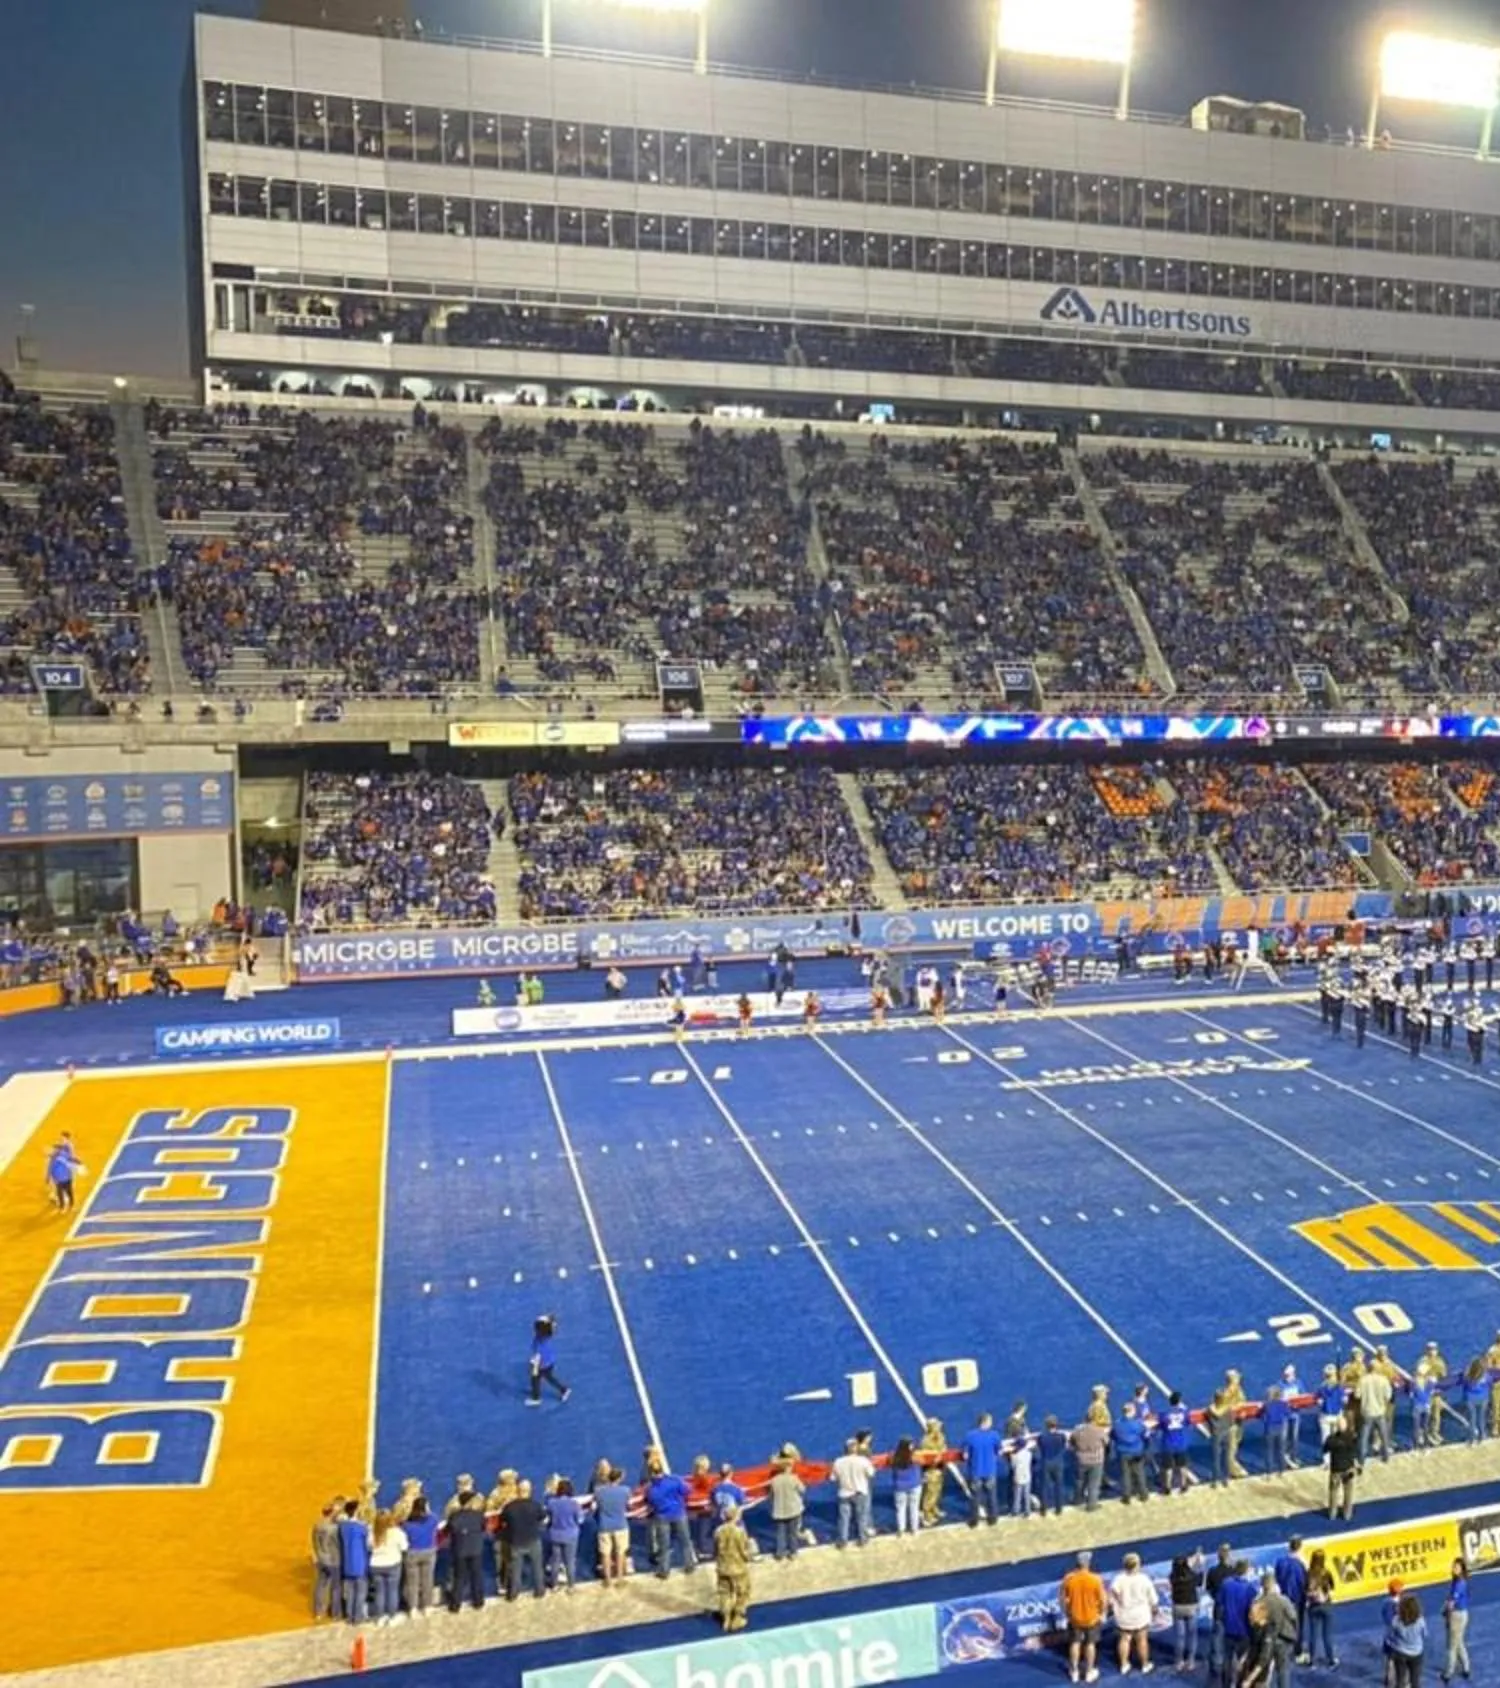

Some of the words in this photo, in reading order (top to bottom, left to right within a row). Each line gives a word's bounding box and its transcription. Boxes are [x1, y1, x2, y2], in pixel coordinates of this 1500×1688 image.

[1100, 300, 1251, 336] Albertsons
[45, 671, 72, 684] 104
[932, 916, 1053, 939] WELCOME
[1059, 913, 1090, 933] TO
[163, 1026, 257, 1047] CAMPING
[258, 1023, 331, 1041] WORLD
[0, 1107, 297, 1493] BRONCOS
[1267, 1303, 1414, 1347] 20
[844, 1359, 979, 1407] 10
[1369, 1537, 1447, 1560] WESTERN
[1370, 1557, 1429, 1580] STATES
[676, 1627, 898, 1688] homie
